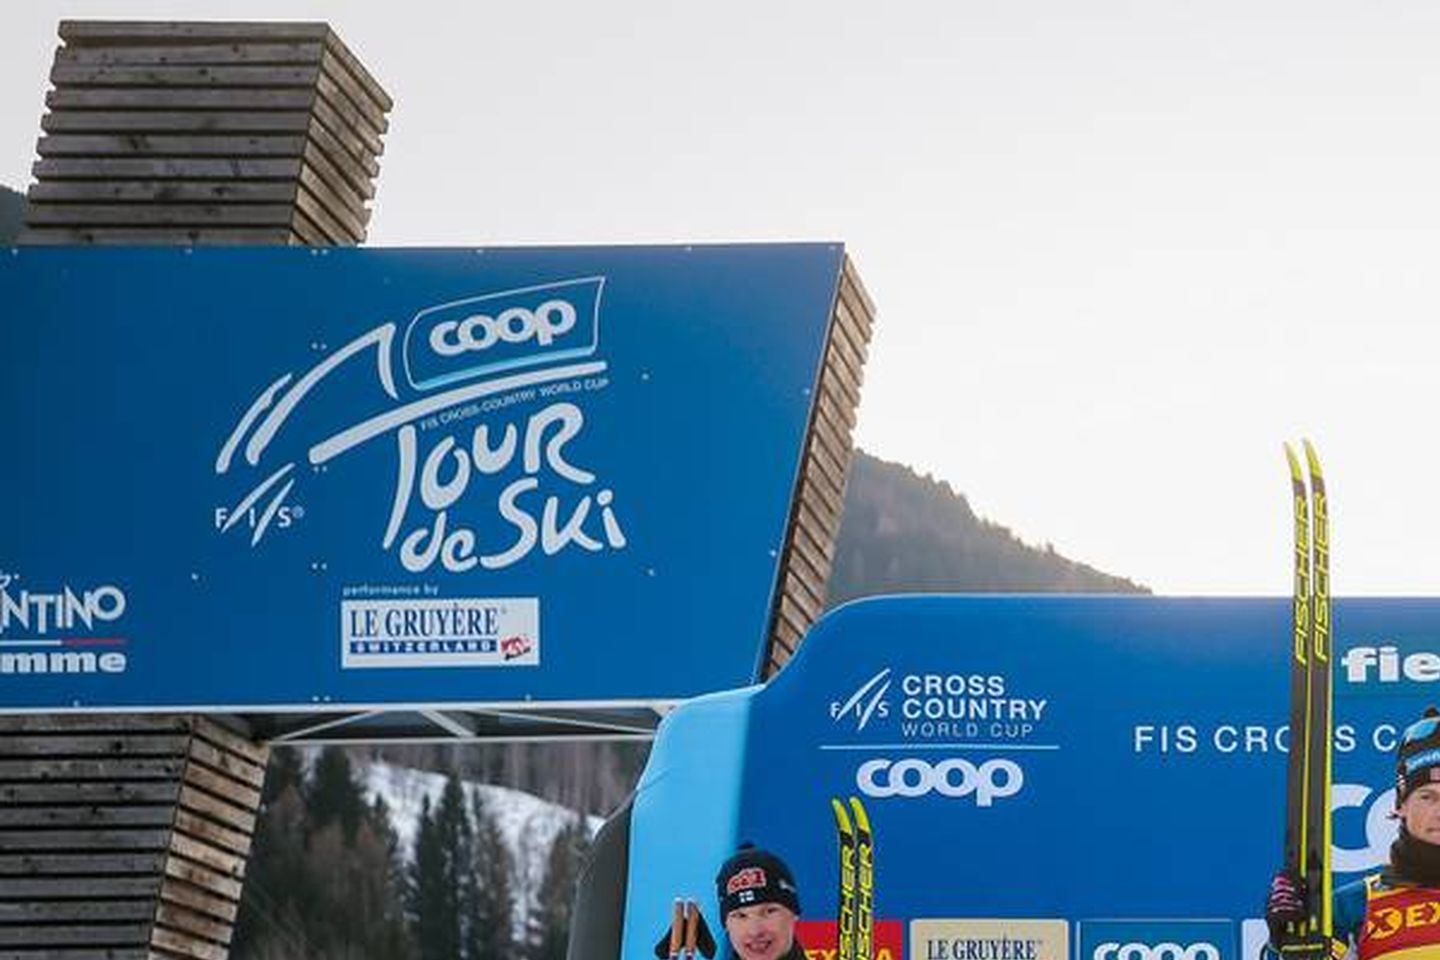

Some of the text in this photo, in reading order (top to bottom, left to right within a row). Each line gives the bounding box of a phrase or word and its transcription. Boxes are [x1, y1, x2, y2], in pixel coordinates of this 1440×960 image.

[428, 299, 577, 357] coop
[399, 477, 627, 574] de Ski
[0, 585, 126, 633] NTINO
[351, 603, 498, 637] LE GRUYÈRE
[0, 653, 126, 673] mme
[902, 675, 1006, 697] CROSS
[901, 698, 1047, 720] COUNTRY
[901, 722, 1033, 737] WORLD CUP
[1135, 726, 1198, 752] FIS
[1213, 725, 1357, 751] CROS
[856, 758, 1024, 807] coop
[927, 936, 1036, 960] LE GRUYÈRE
